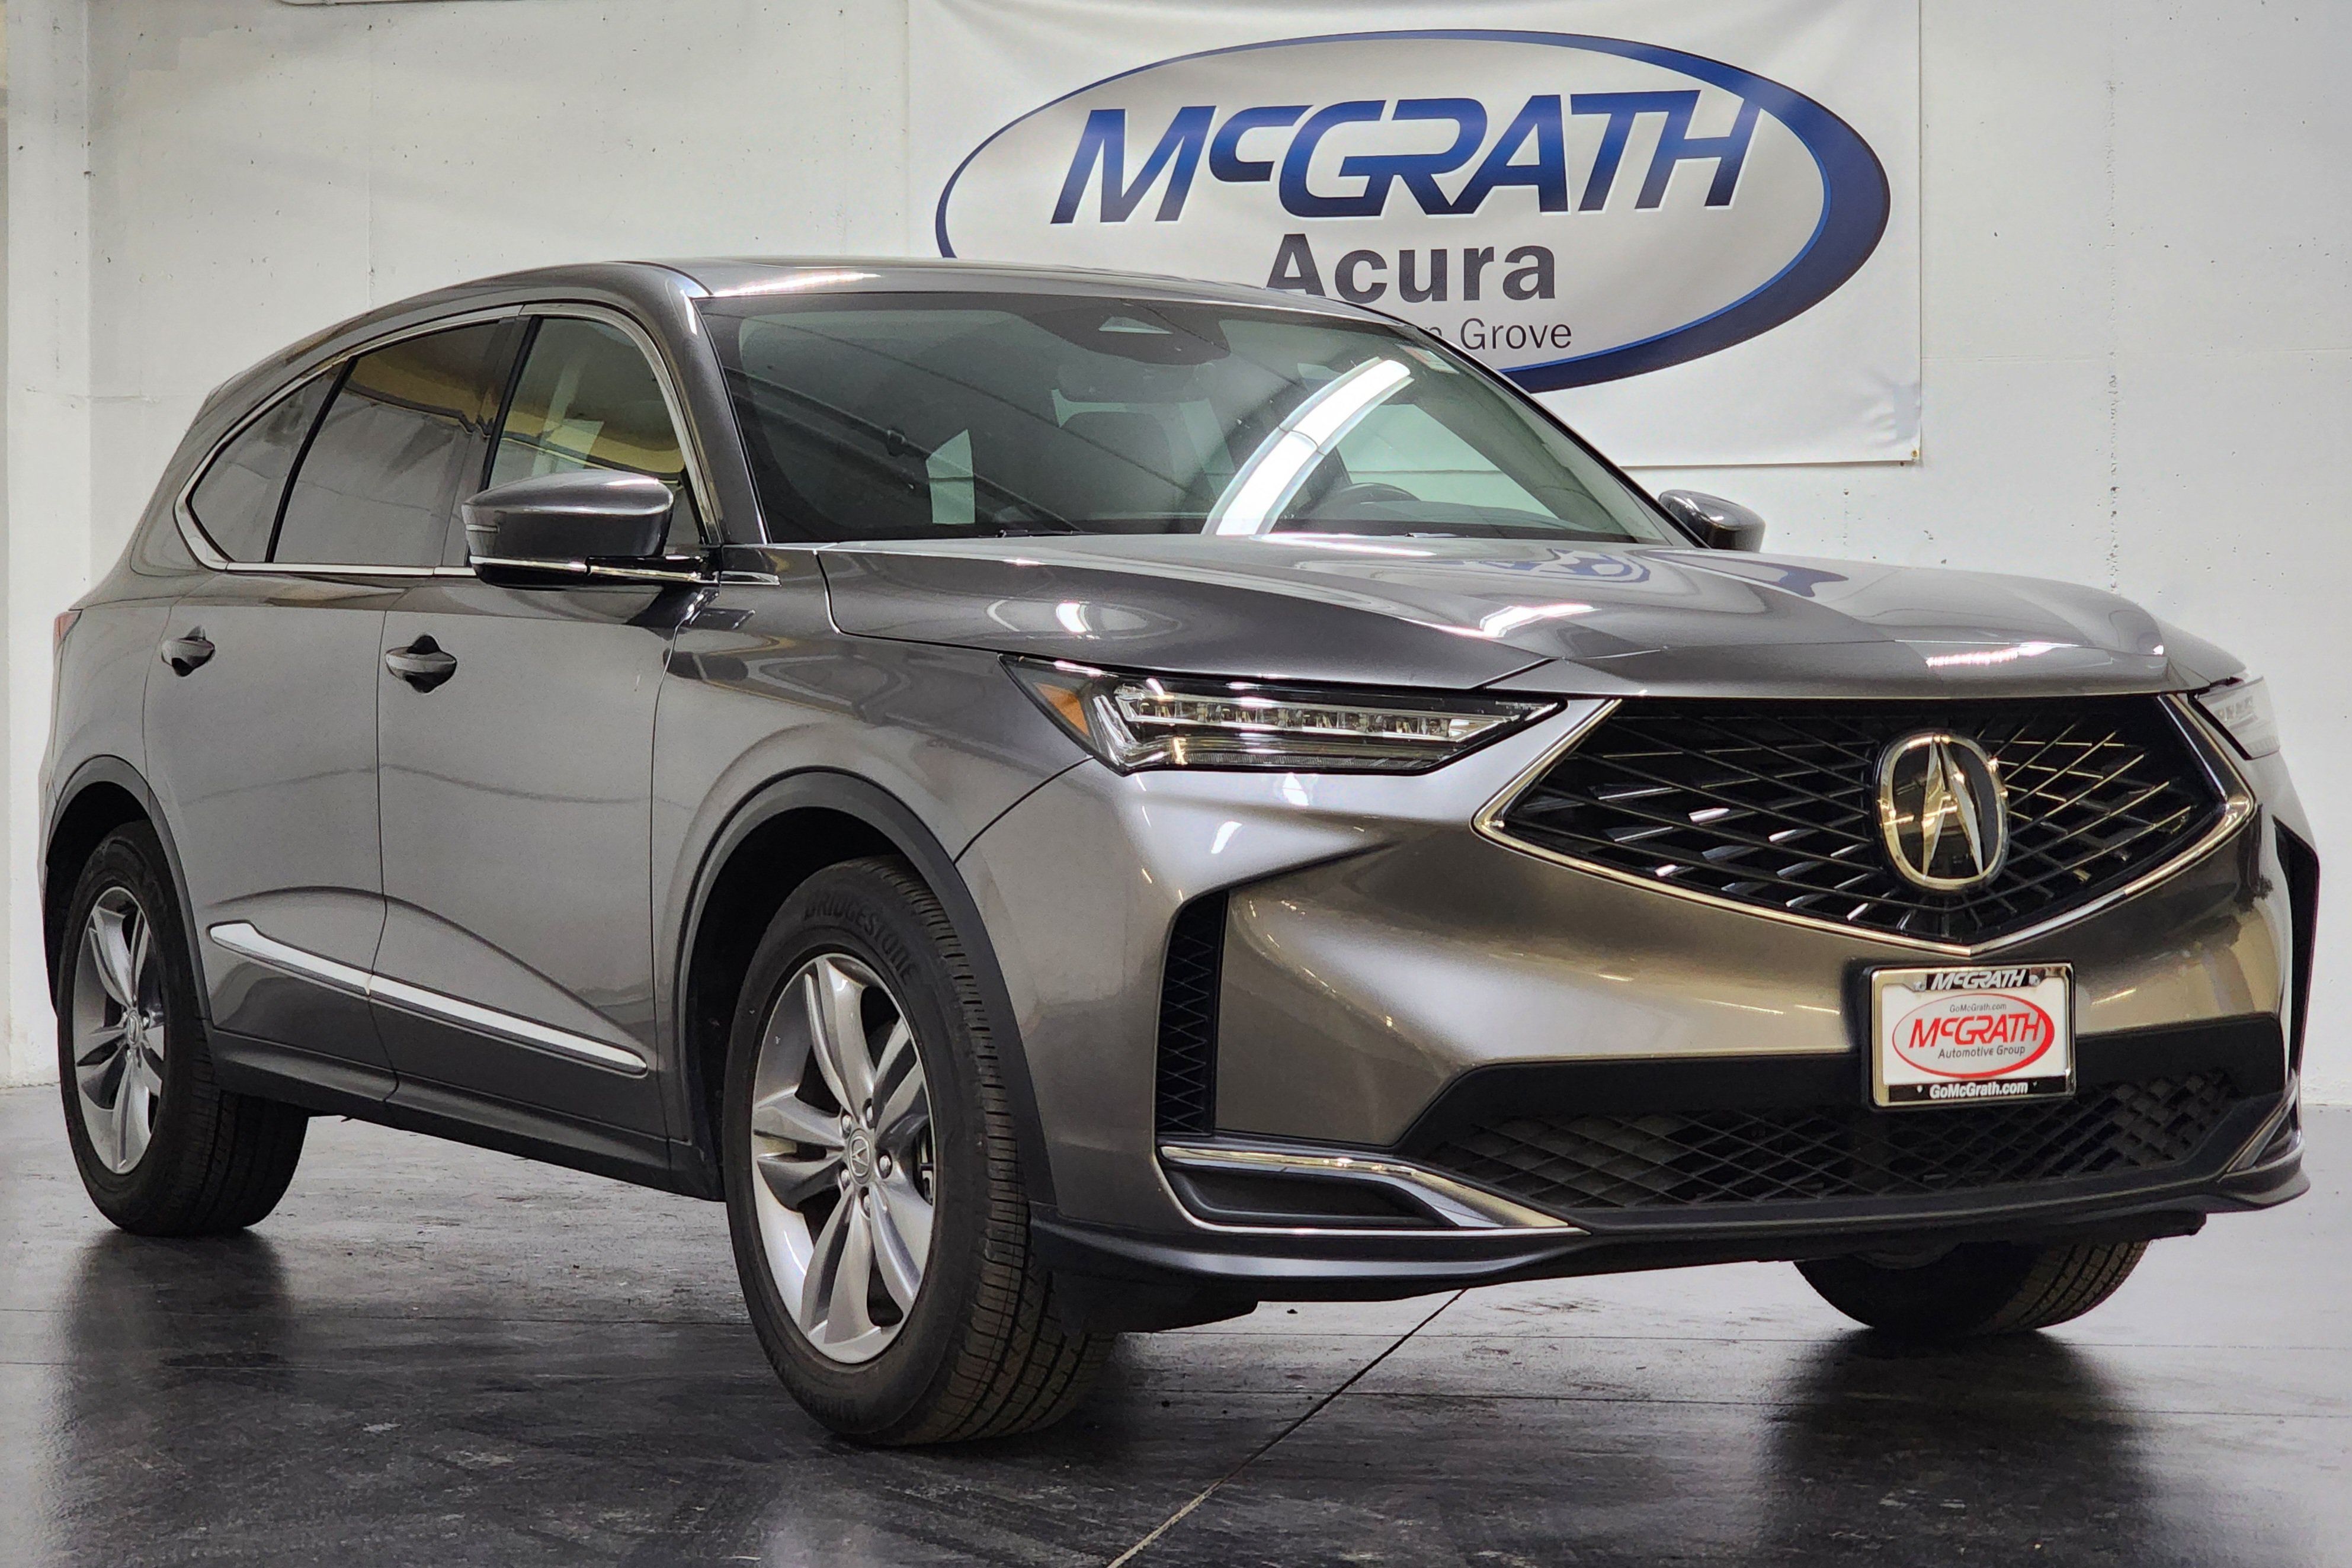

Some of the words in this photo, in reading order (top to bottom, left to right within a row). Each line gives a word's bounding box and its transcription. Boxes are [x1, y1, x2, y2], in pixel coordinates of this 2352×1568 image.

[1265, 233, 1557, 304] Acura
[1461, 318, 1572, 350] Grove
[803, 889, 916, 986] BRIDGESTONE
[1950, 1003, 2007, 1013] GoMcGrath.com
[1938, 1046, 1994, 1059] Automotive
[1997, 1045, 2026, 1056] Group
[1929, 1082, 2029, 1099] GoMcGrath.com
